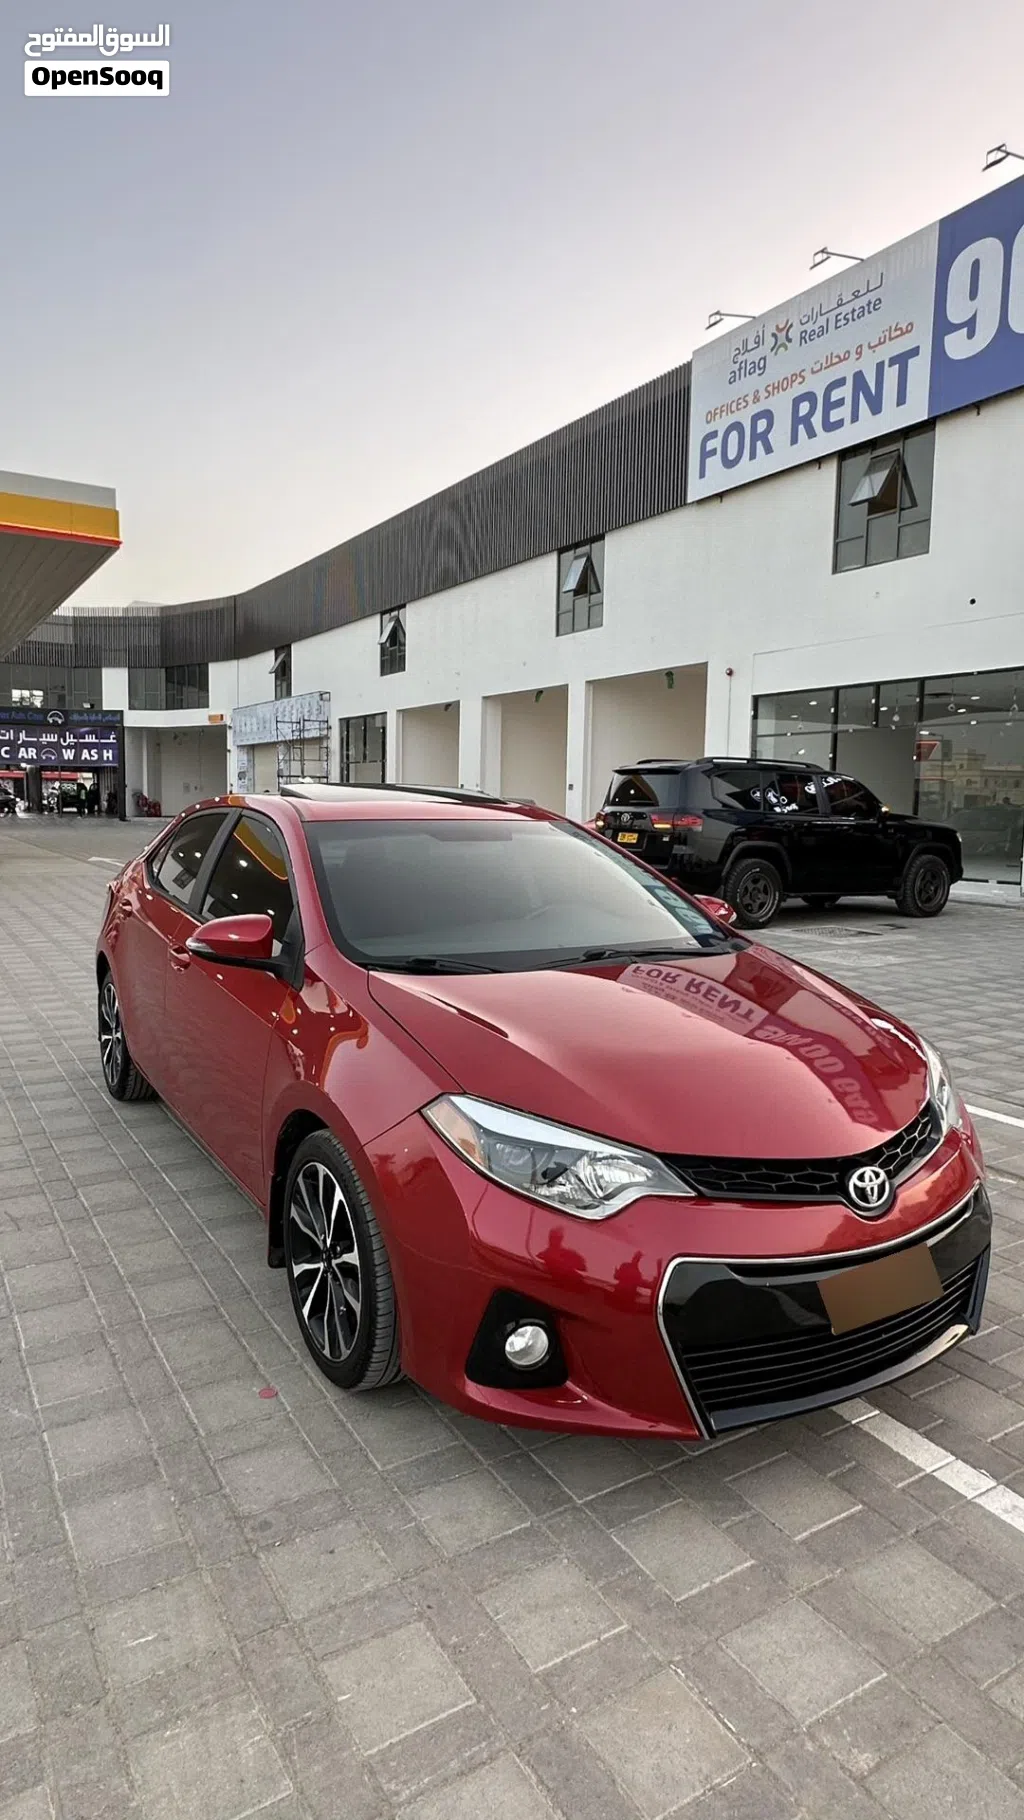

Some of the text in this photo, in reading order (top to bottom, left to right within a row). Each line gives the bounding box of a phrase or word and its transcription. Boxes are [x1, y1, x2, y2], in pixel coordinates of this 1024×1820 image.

[799, 297, 882, 347] Real Estate
[800, 272, 884, 326] للعقارات
[732, 324, 766, 364] أفلاج
[811, 321, 914, 375] مكاتب و محلات
[728, 355, 767, 385] aflag
[699, 345, 920, 480] FOR RENT
[705, 369, 806, 424] OFFICES & SHOPS
[60, 731, 117, 746] غسيل
[62, 748, 113, 760] WASH
